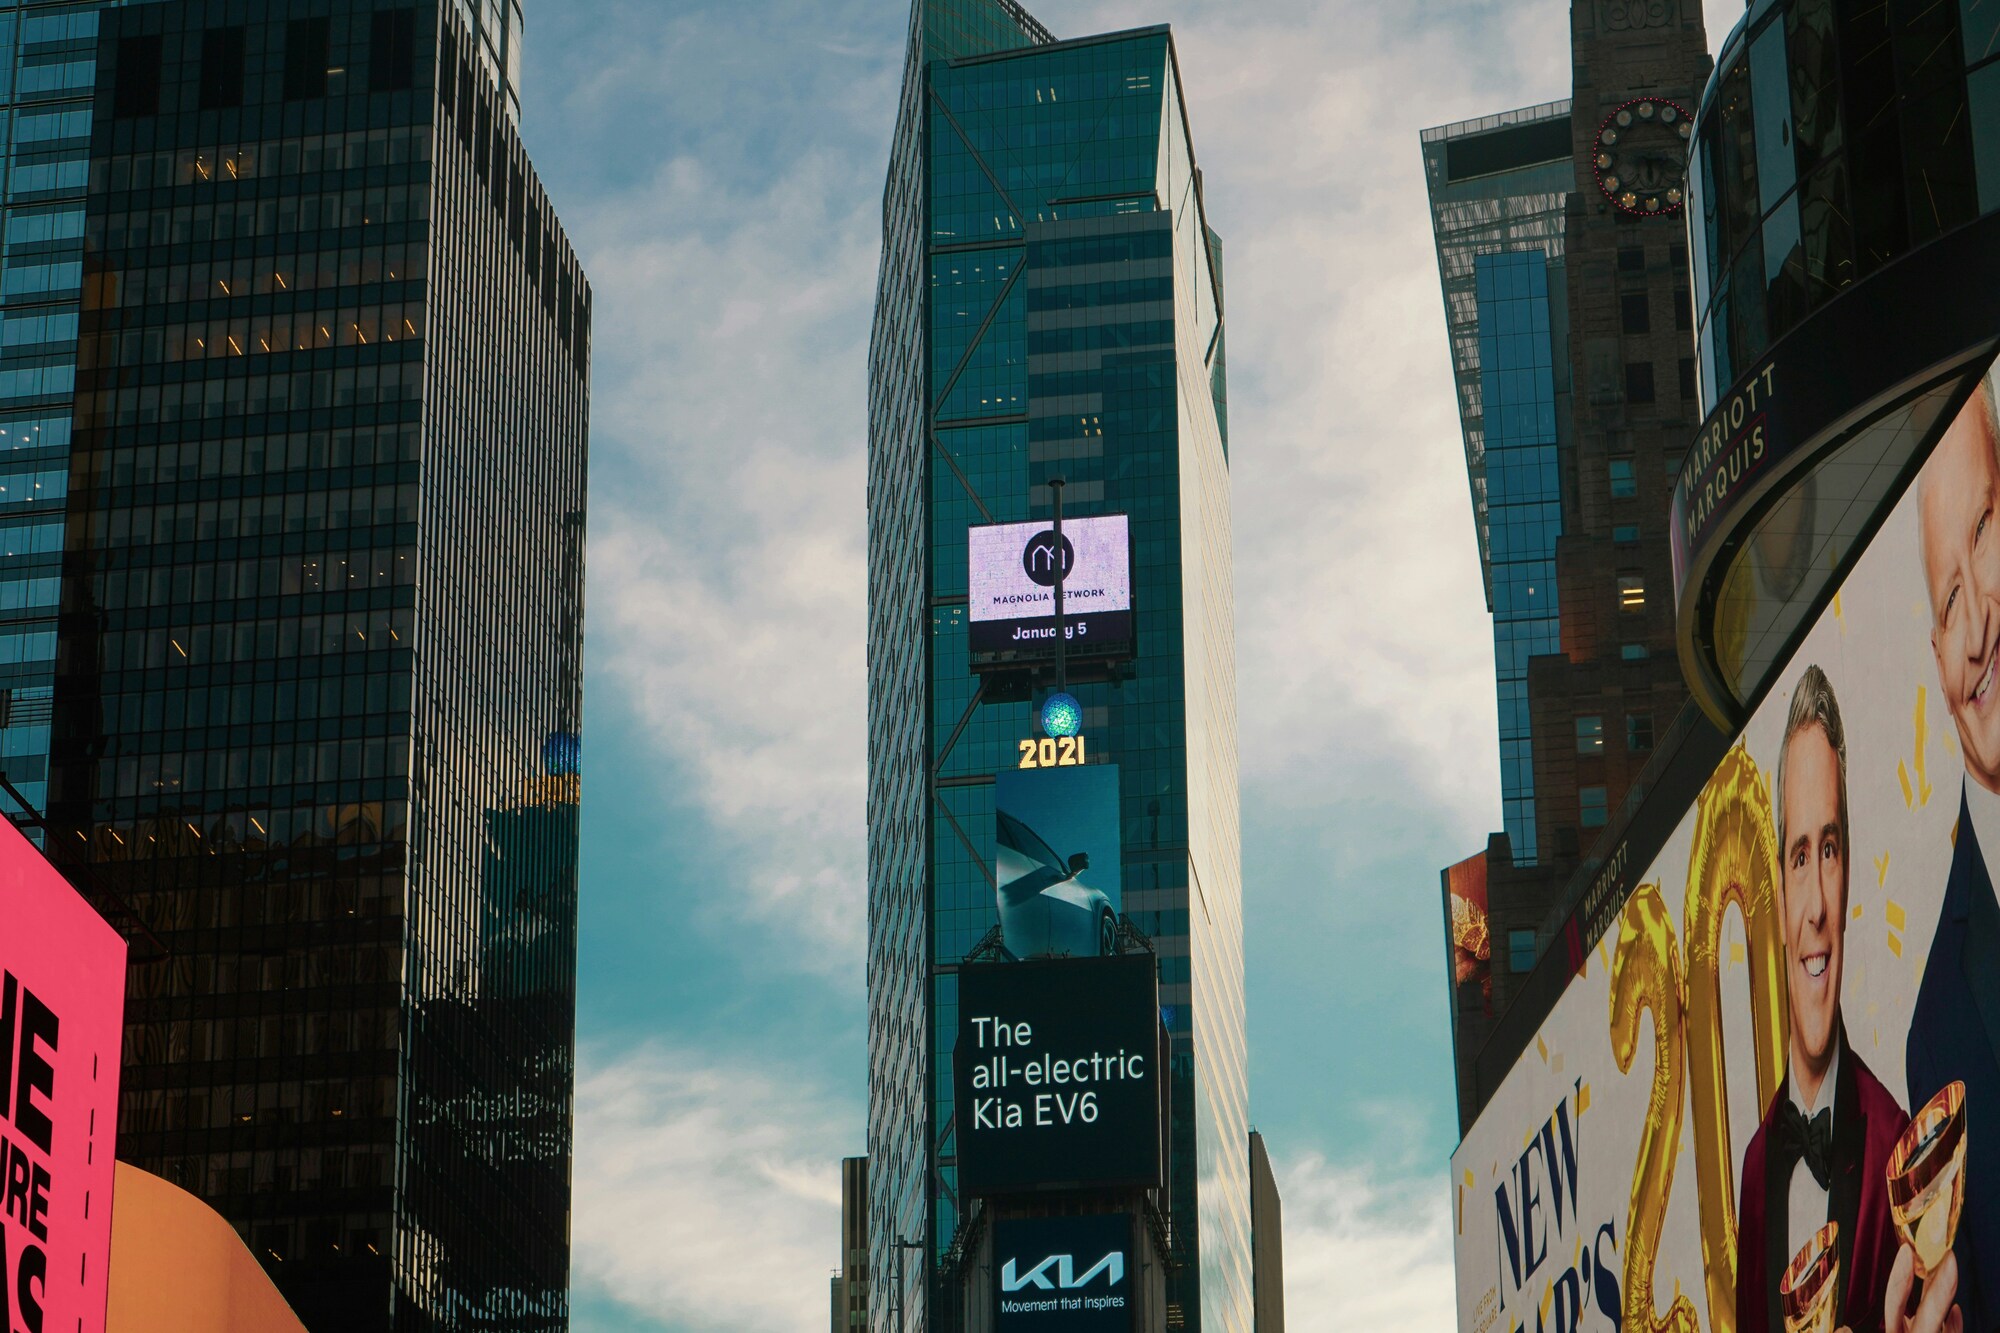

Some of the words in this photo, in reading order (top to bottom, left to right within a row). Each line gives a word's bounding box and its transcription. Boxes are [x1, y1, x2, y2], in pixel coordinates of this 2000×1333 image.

[1685, 362, 1775, 500] MARRIOTT
[1688, 426, 1764, 546] MARQUIS
[993, 593, 1049, 605] MAGNOLIA
[1012, 626, 1073, 641] Januay
[1077, 622, 1087, 635] 5
[1019, 736, 1085, 769] 2021
[1585, 840, 1628, 920] MARRIOTT
[1586, 883, 1625, 954] MARQUIS
[971, 1016, 1032, 1048] The
[972, 1049, 1144, 1089] all-electric
[973, 1097, 1023, 1129] Kia
[1035, 1092, 1099, 1127] EV6
[1494, 1075, 1581, 1314] NEW
[1002, 1299, 1058, 1313] Movement
[1061, 1297, 1082, 1310] that
[1084, 1295, 1124, 1311] inspires
